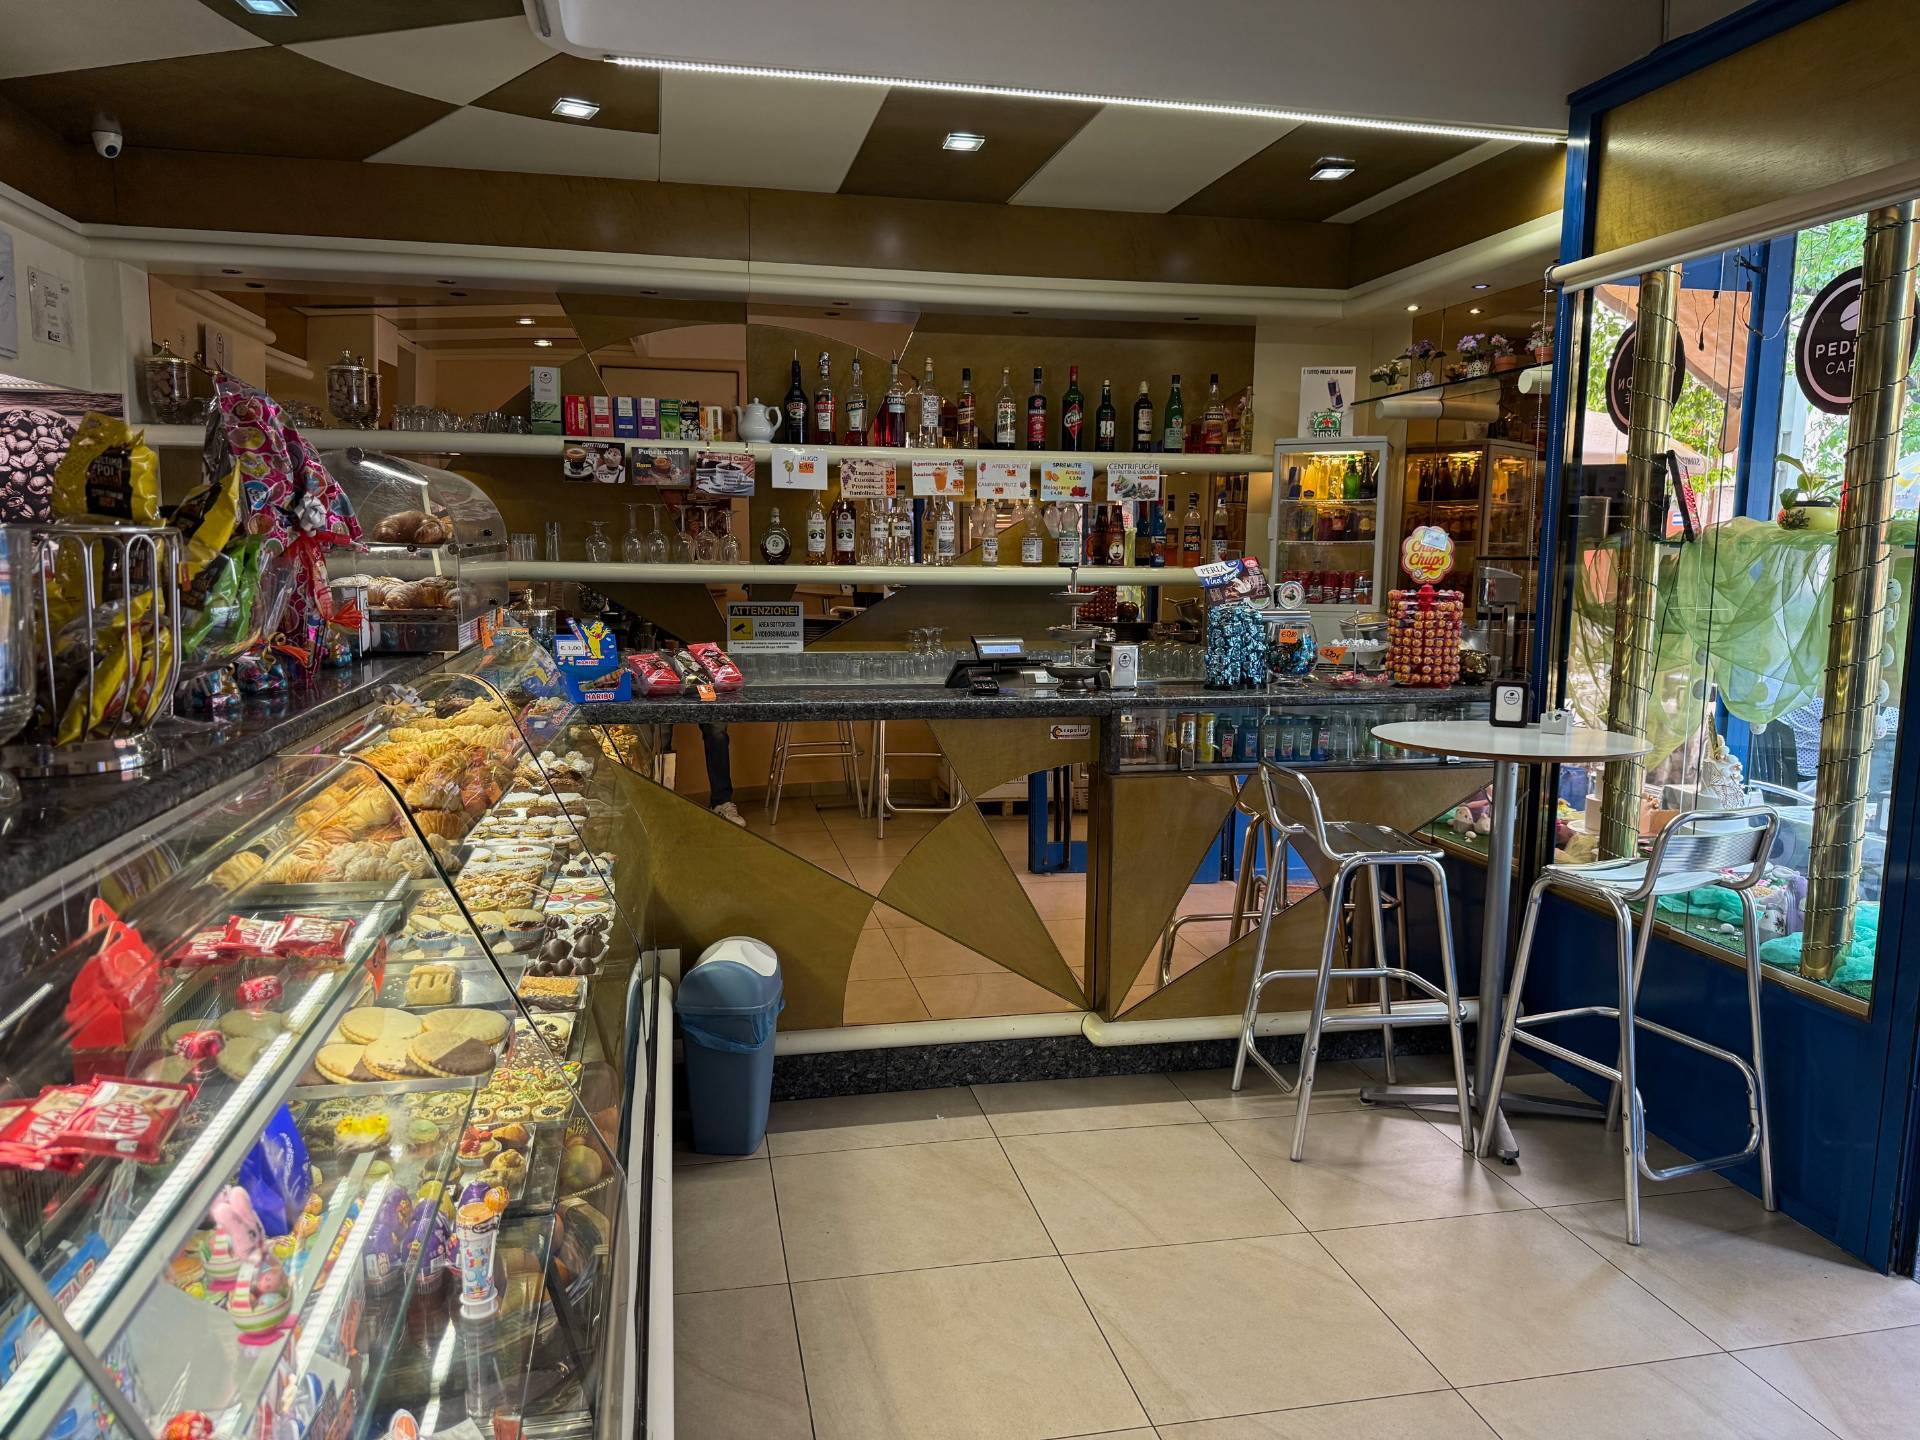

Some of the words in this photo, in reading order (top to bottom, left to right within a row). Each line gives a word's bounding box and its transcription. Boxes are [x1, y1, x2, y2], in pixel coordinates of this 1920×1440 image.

[1409, 553, 1445, 568] Chups
[732, 606, 798, 615] ATTENZIONE!
[585, 692, 615, 701] HARIBO
